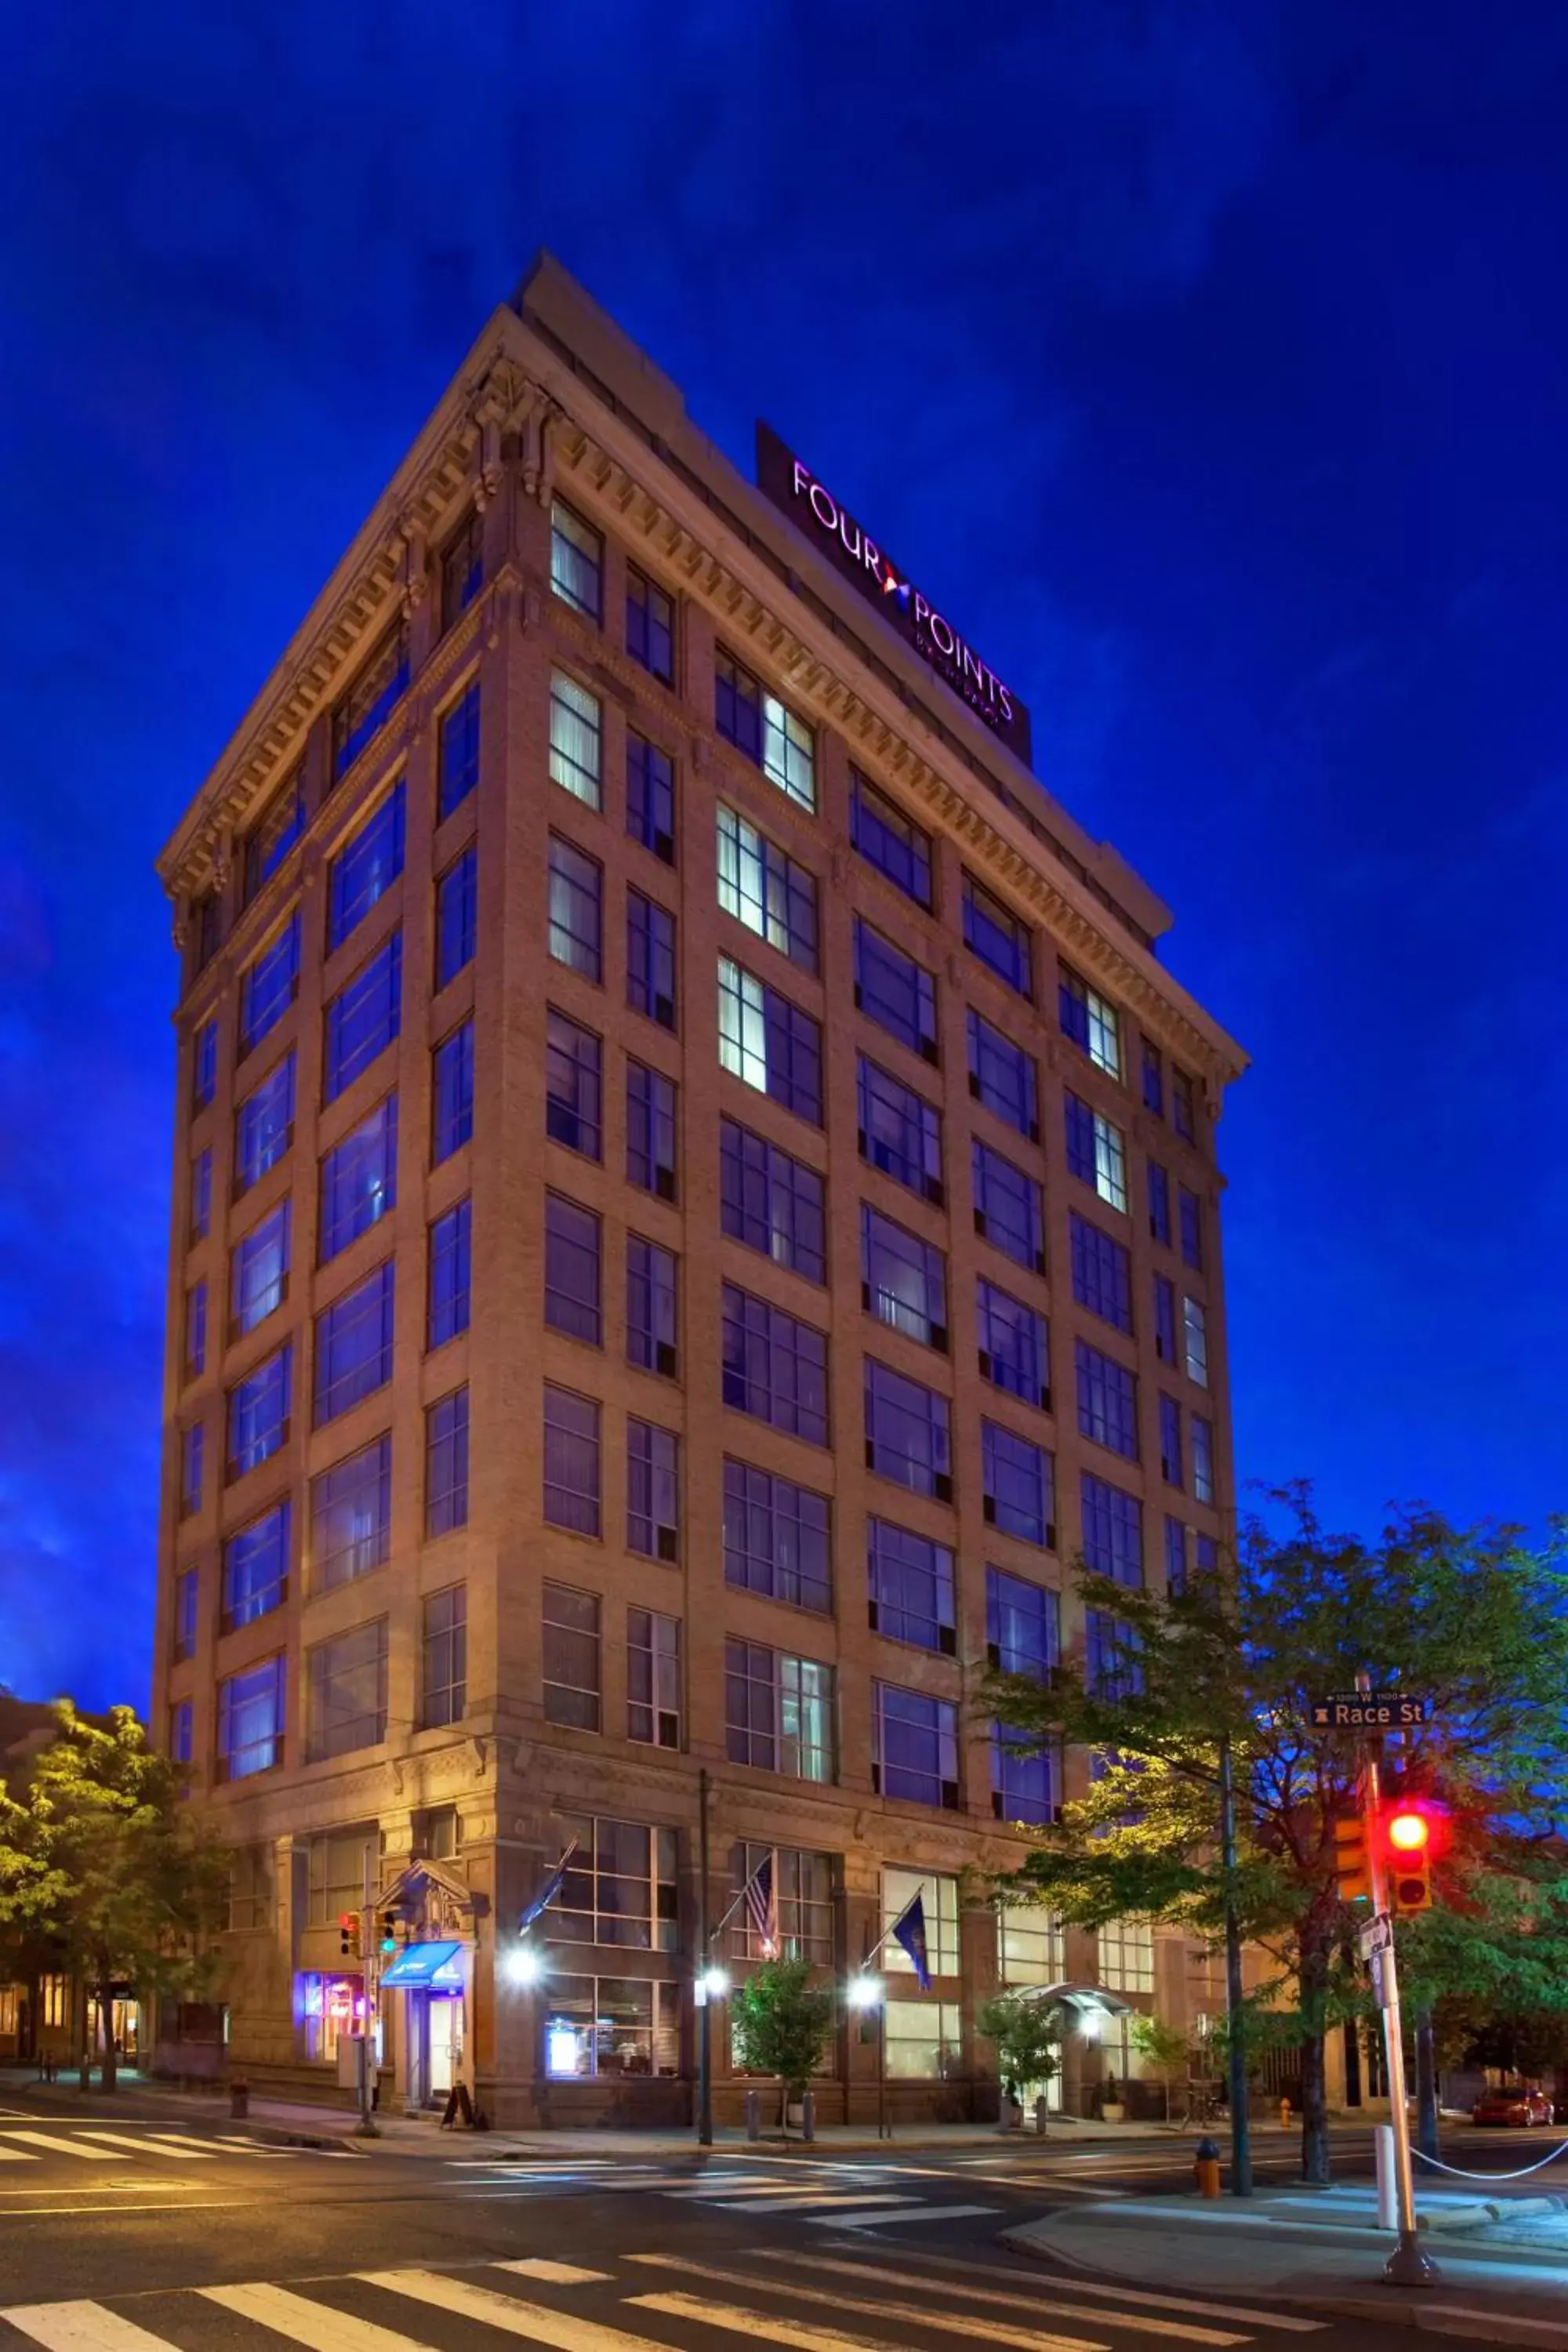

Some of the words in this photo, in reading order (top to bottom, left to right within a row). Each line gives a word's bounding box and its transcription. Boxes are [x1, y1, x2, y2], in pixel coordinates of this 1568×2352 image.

[794, 460, 883, 584] FOUR
[915, 591, 1013, 720] POINTS
[1335, 1704, 1391, 1725] Race
[1400, 1703, 1423, 1722] St
